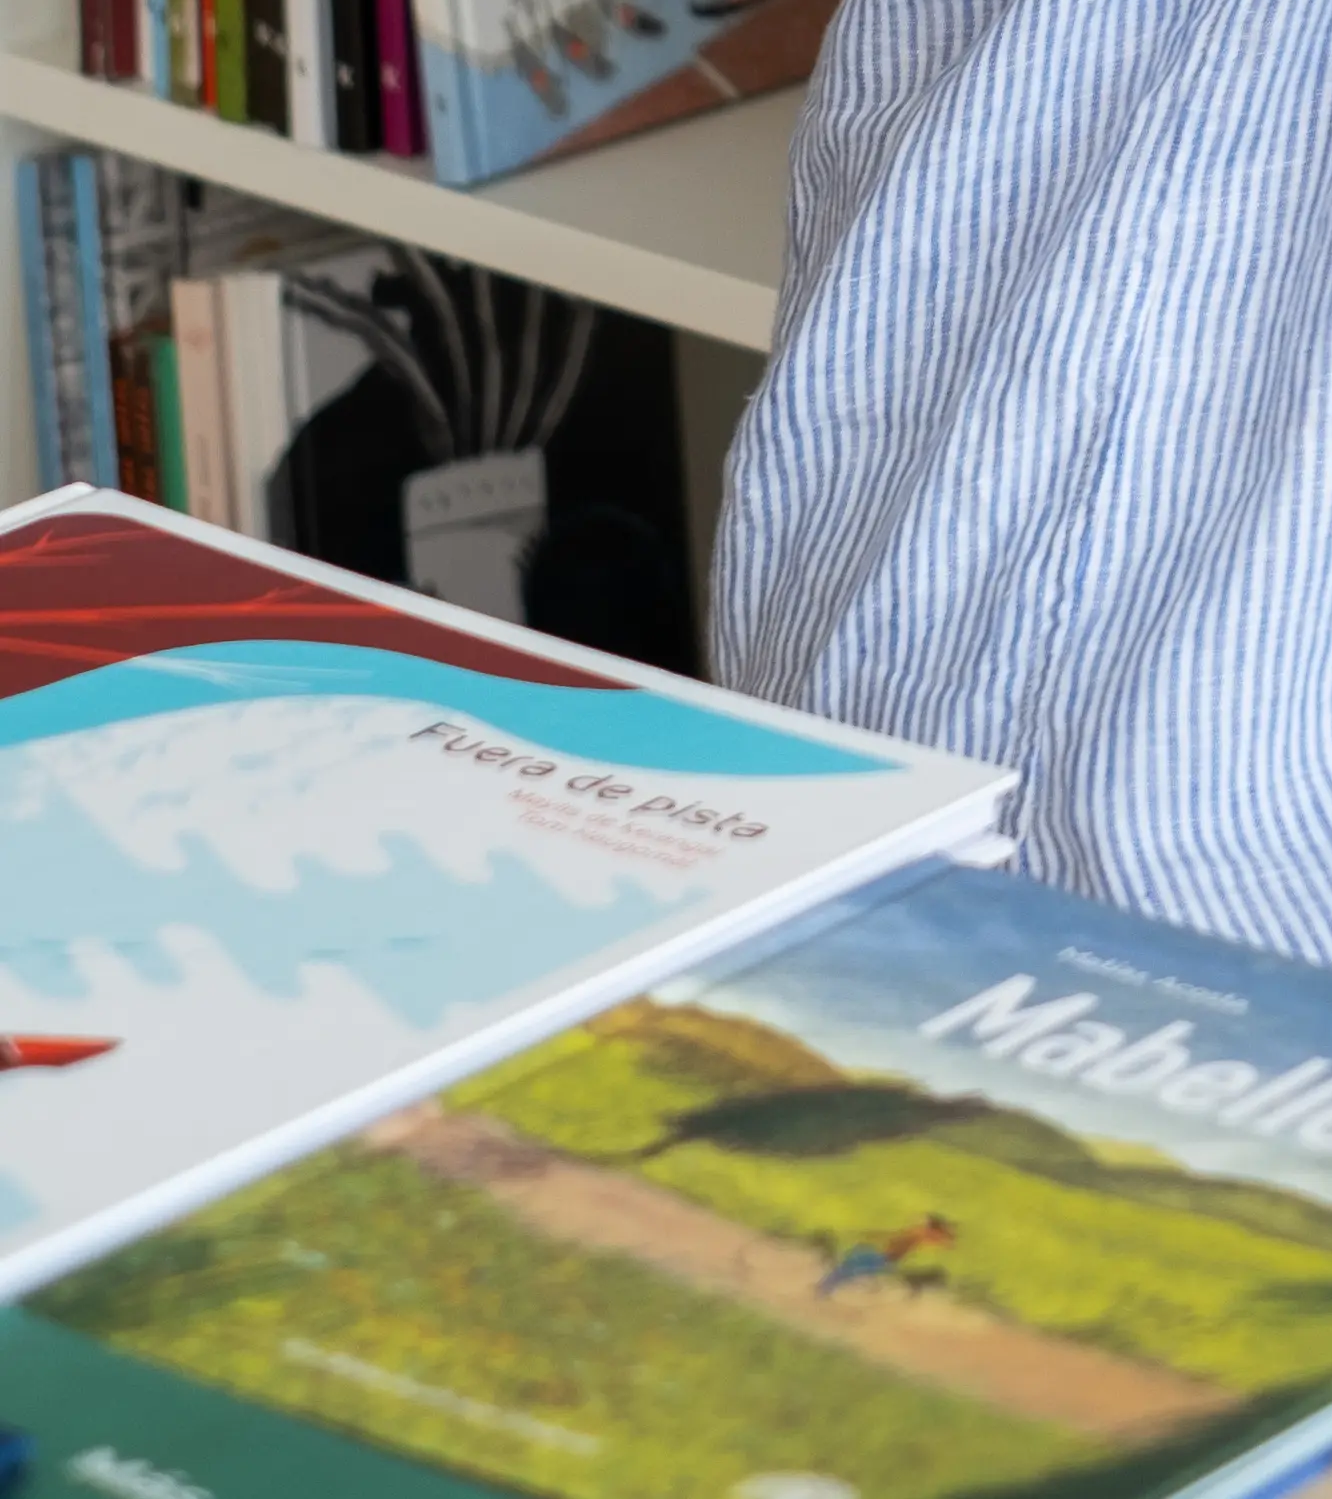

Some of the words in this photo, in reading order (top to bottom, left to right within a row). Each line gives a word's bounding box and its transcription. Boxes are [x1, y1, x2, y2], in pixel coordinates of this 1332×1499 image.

[407, 720, 558, 796] Fuera
[564, 772, 635, 802] de
[626, 794, 770, 842] pista
